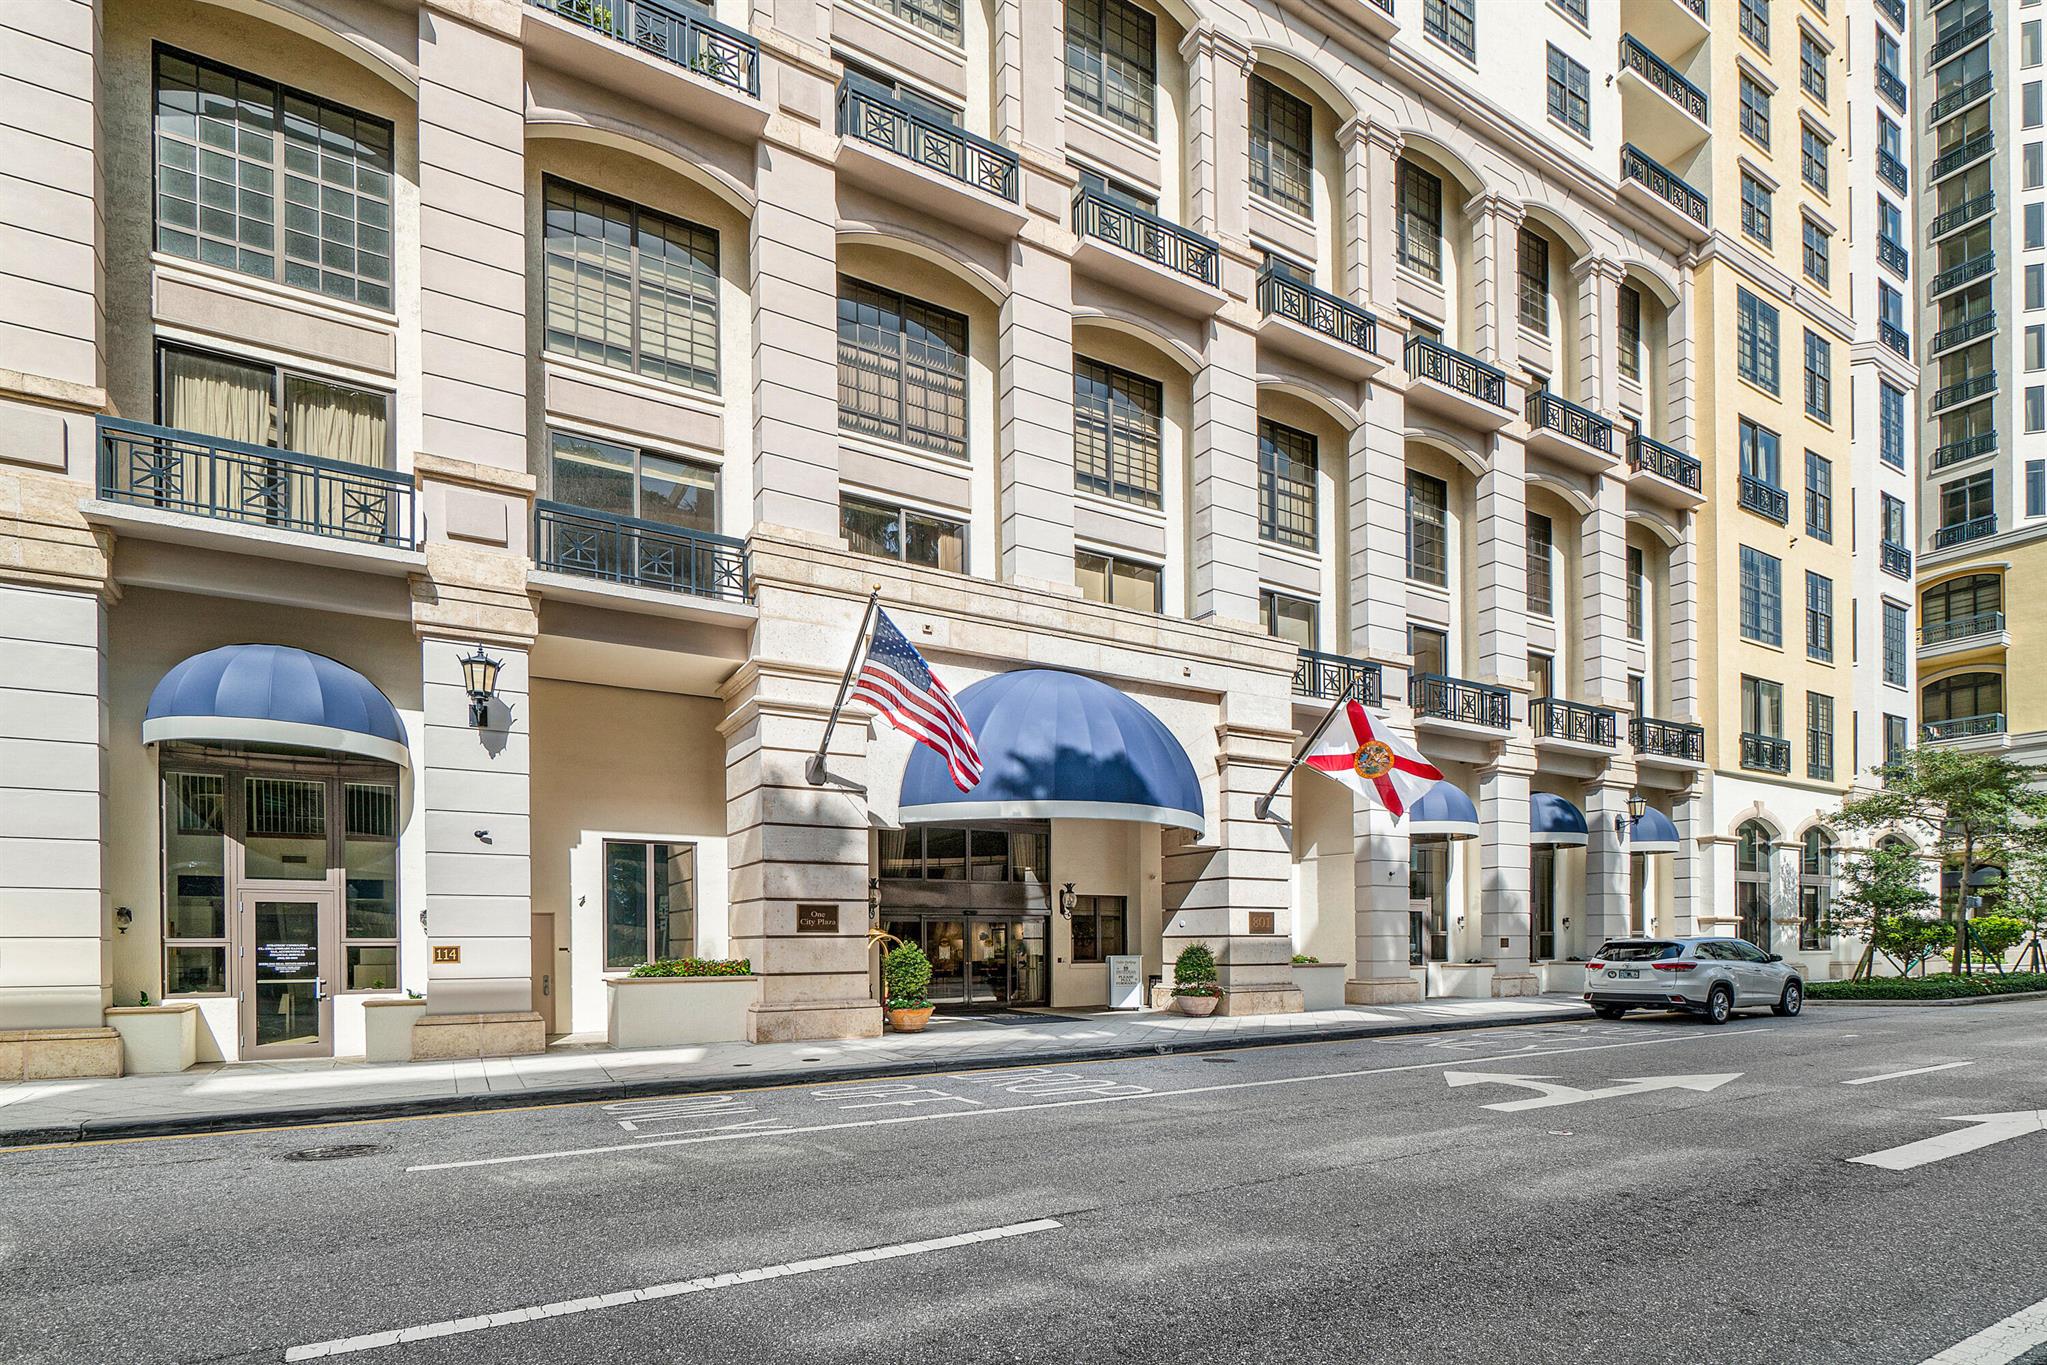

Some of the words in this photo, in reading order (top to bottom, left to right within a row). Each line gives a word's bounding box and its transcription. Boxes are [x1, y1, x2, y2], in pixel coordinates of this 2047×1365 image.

[810, 910, 826, 918] One
[800, 918, 816, 927] City
[1252, 916, 1270, 928] 801
[436, 949, 457, 960] 114
[947, 1068, 1154, 1097] DROP
[810, 1084, 984, 1110] OFF
[601, 1095, 795, 1139] ONLY
